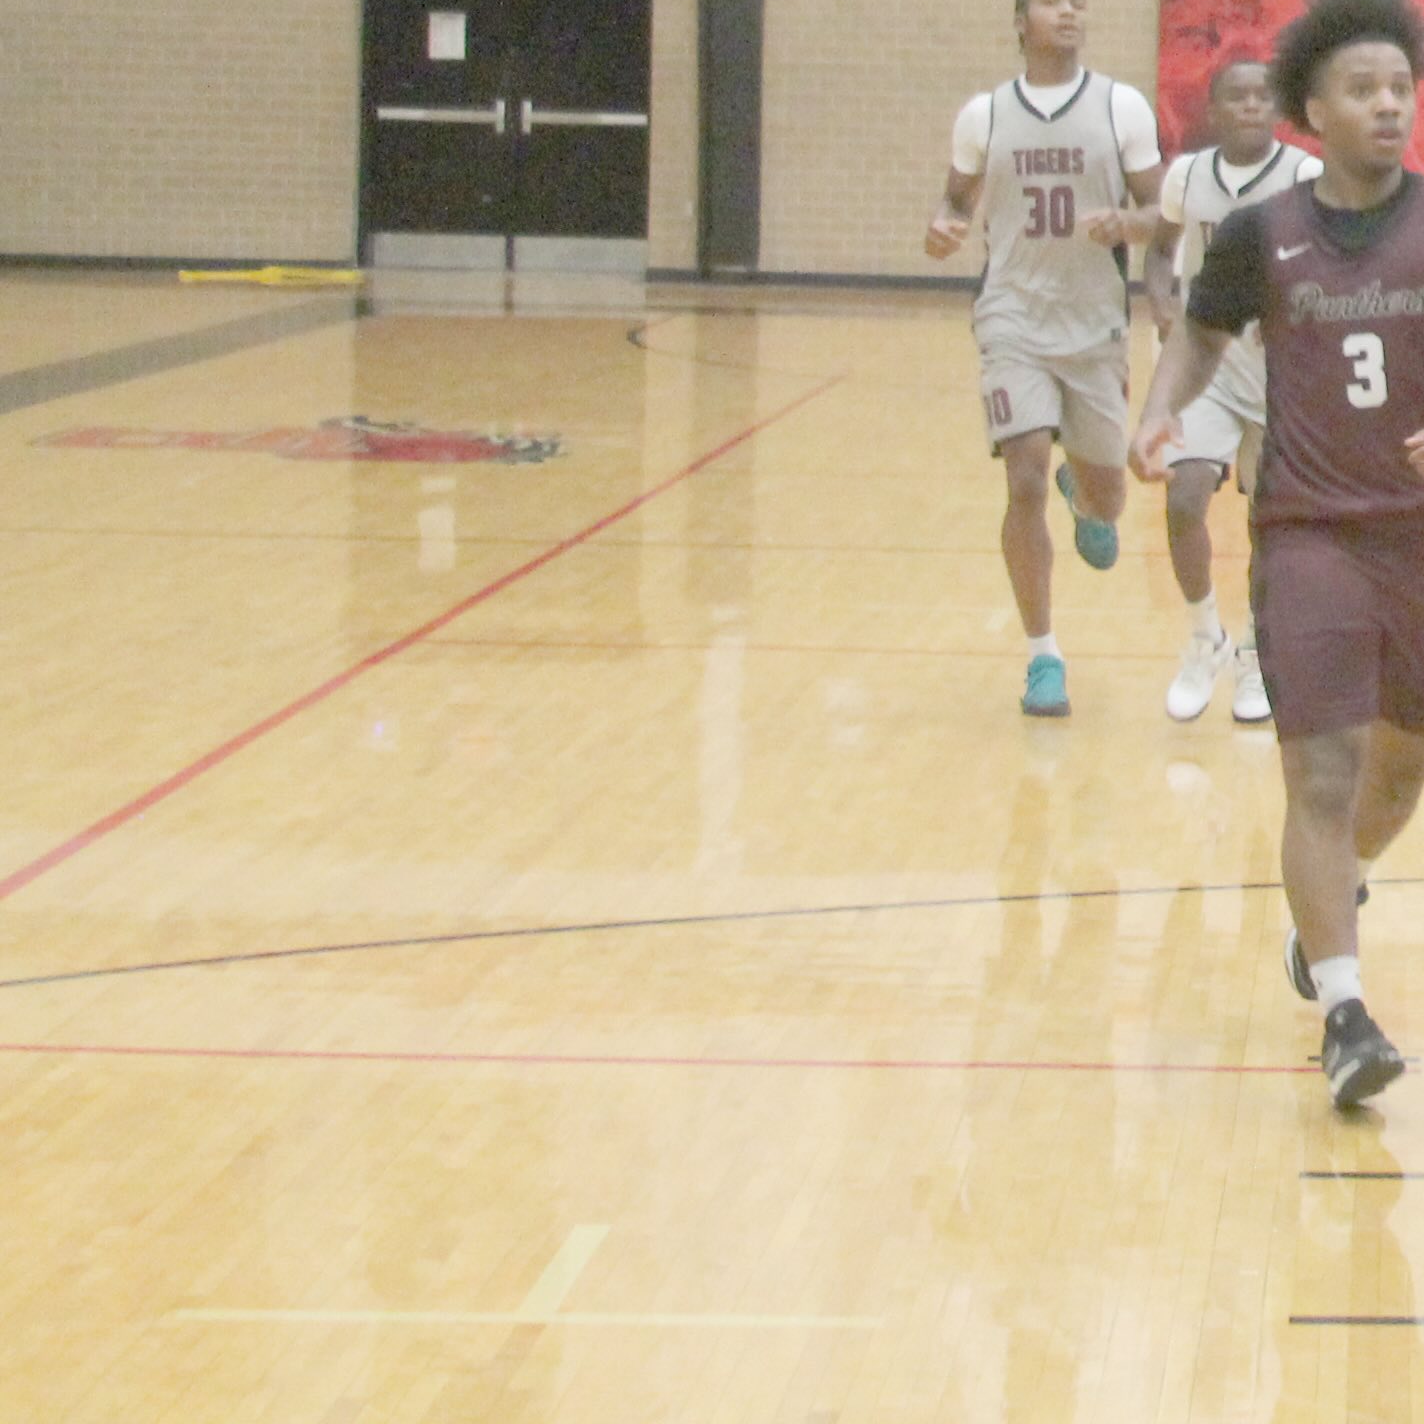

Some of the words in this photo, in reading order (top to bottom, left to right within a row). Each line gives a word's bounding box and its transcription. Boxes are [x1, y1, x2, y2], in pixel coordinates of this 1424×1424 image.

[1013, 147, 1085, 176] TIGERS
[1023, 186, 1075, 238] 30
[1342, 332, 1388, 409] 3
